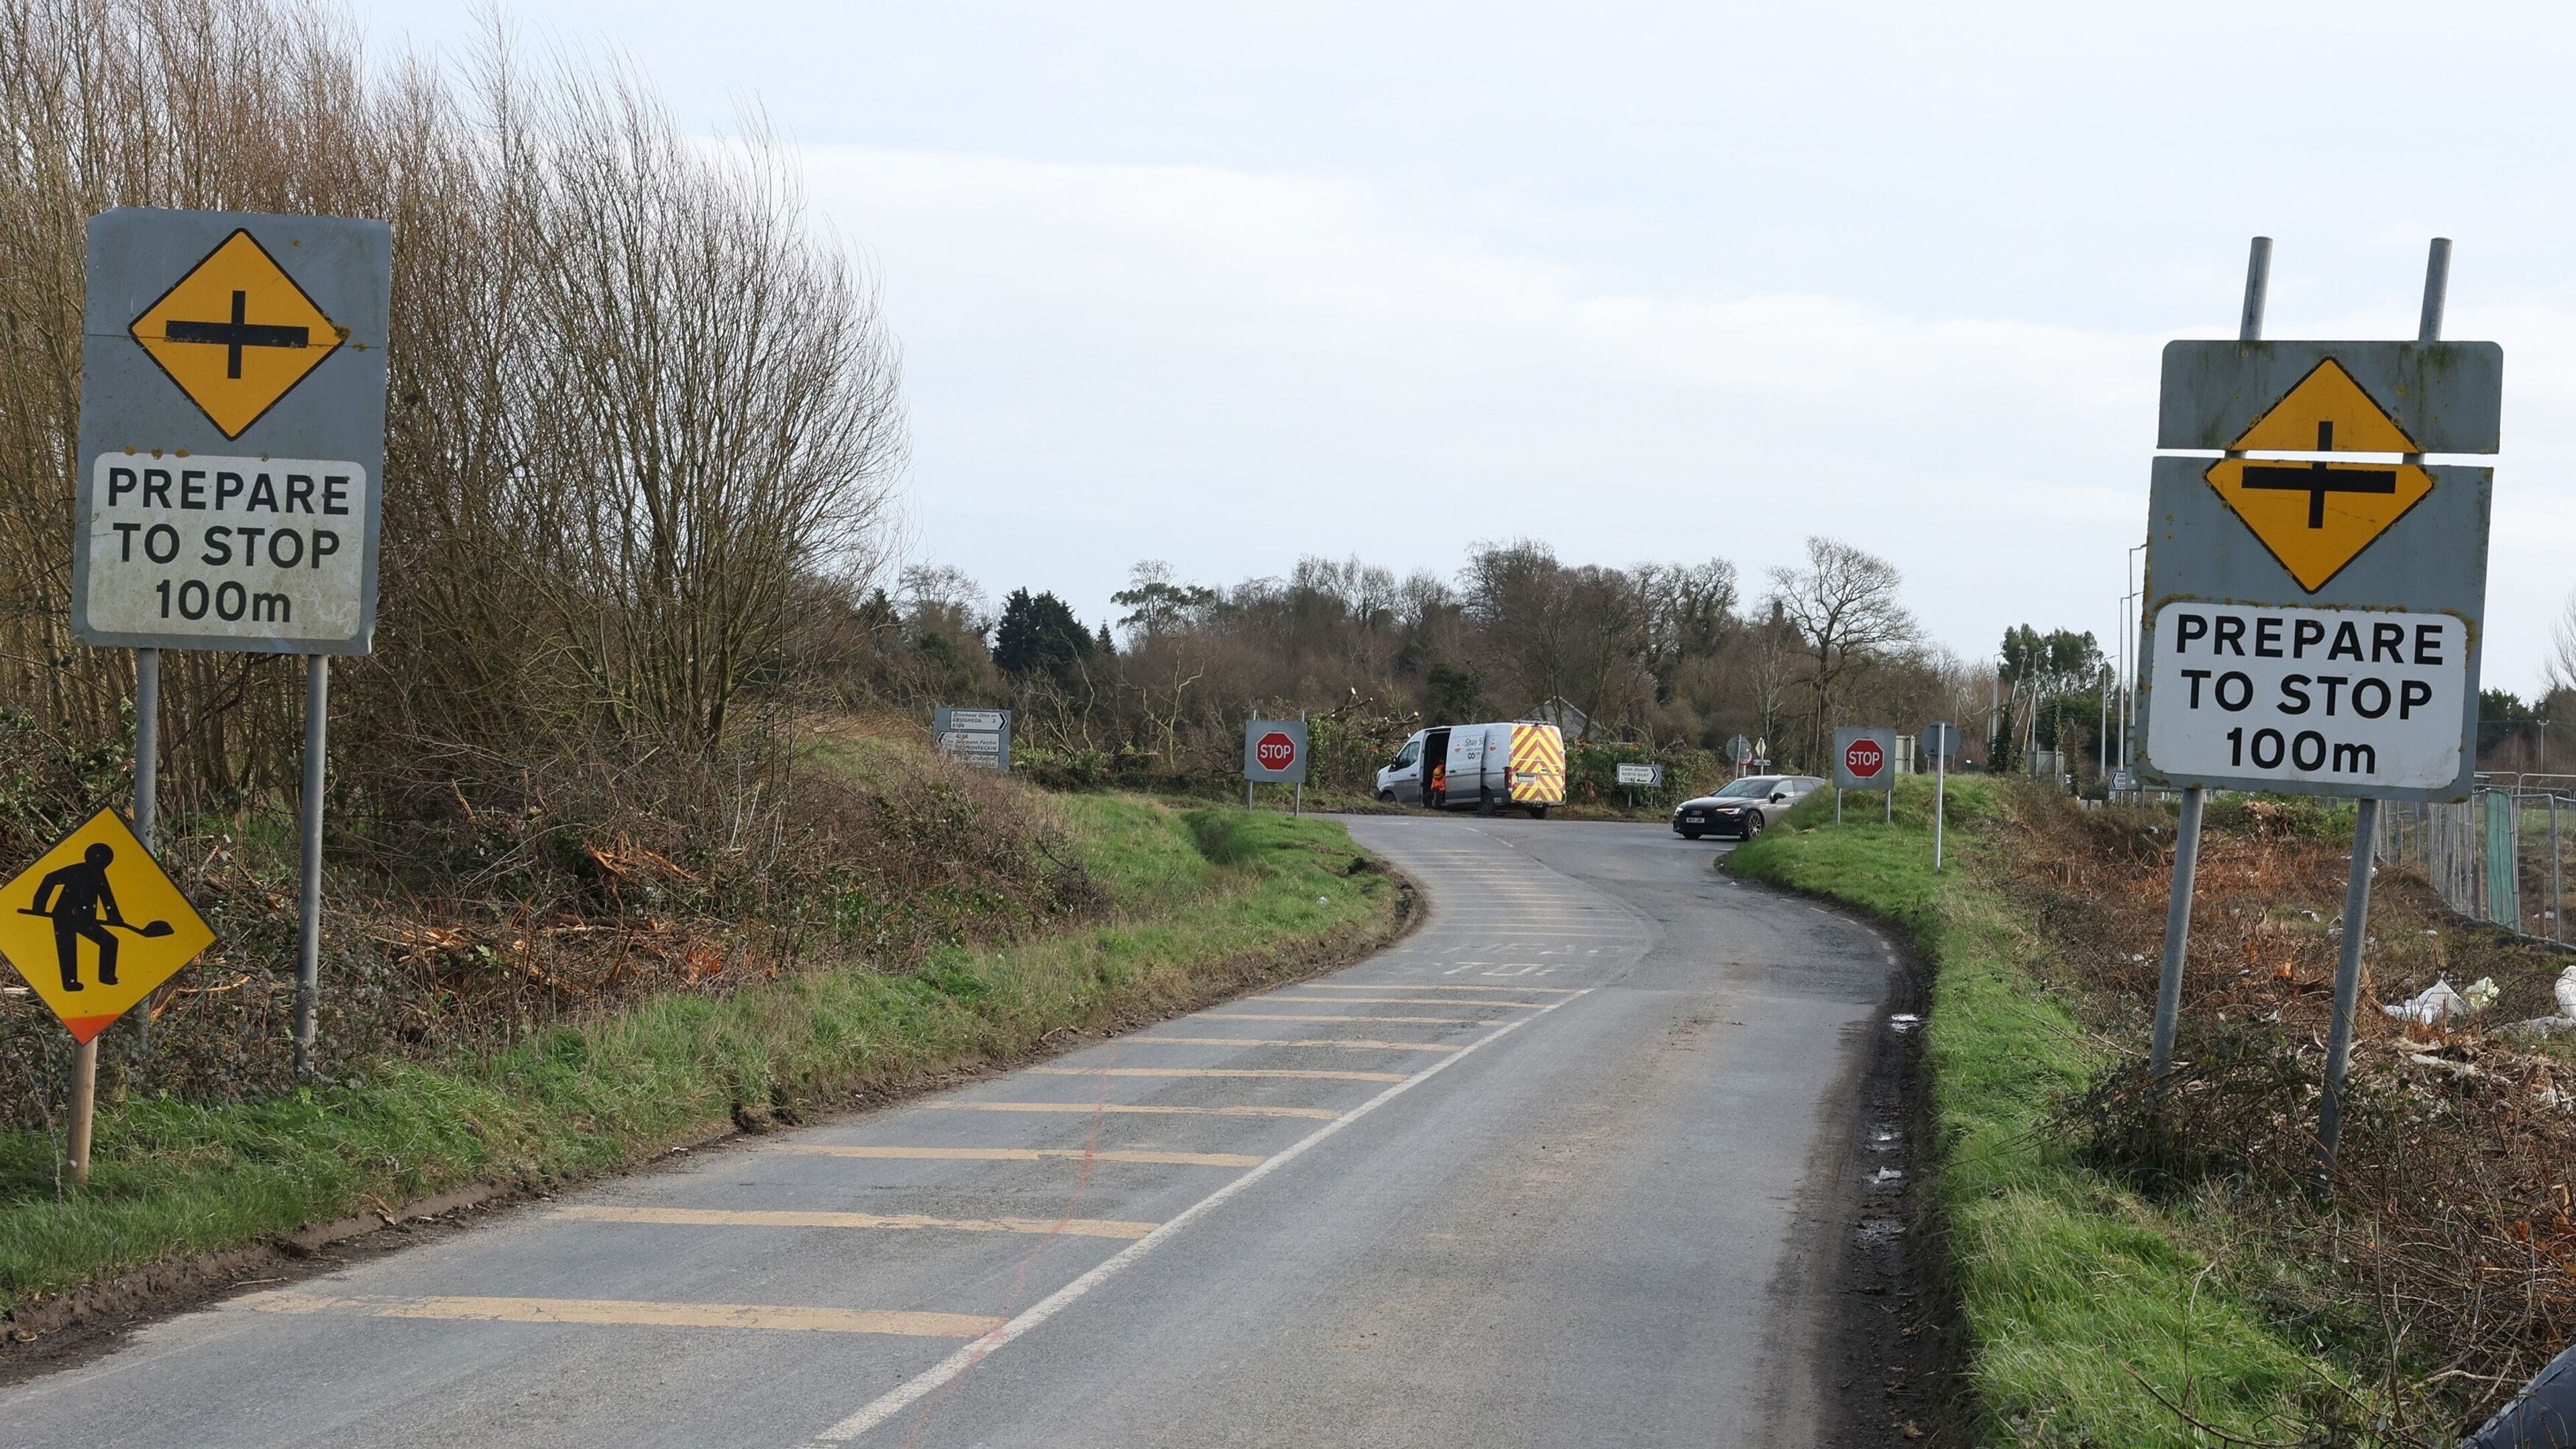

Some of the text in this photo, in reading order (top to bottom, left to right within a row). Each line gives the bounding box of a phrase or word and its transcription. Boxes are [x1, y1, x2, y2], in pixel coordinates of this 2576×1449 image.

[108, 467, 350, 515] PREPARE
[113, 522, 340, 569] TO STOP
[156, 579, 291, 623] 100m
[2176, 613, 2443, 665] PREPARE
[2181, 669, 2432, 720] TO STOP
[1260, 744, 1291, 759] STOP
[1848, 751, 1880, 766] STOP
[2226, 727, 2376, 775] 100m
